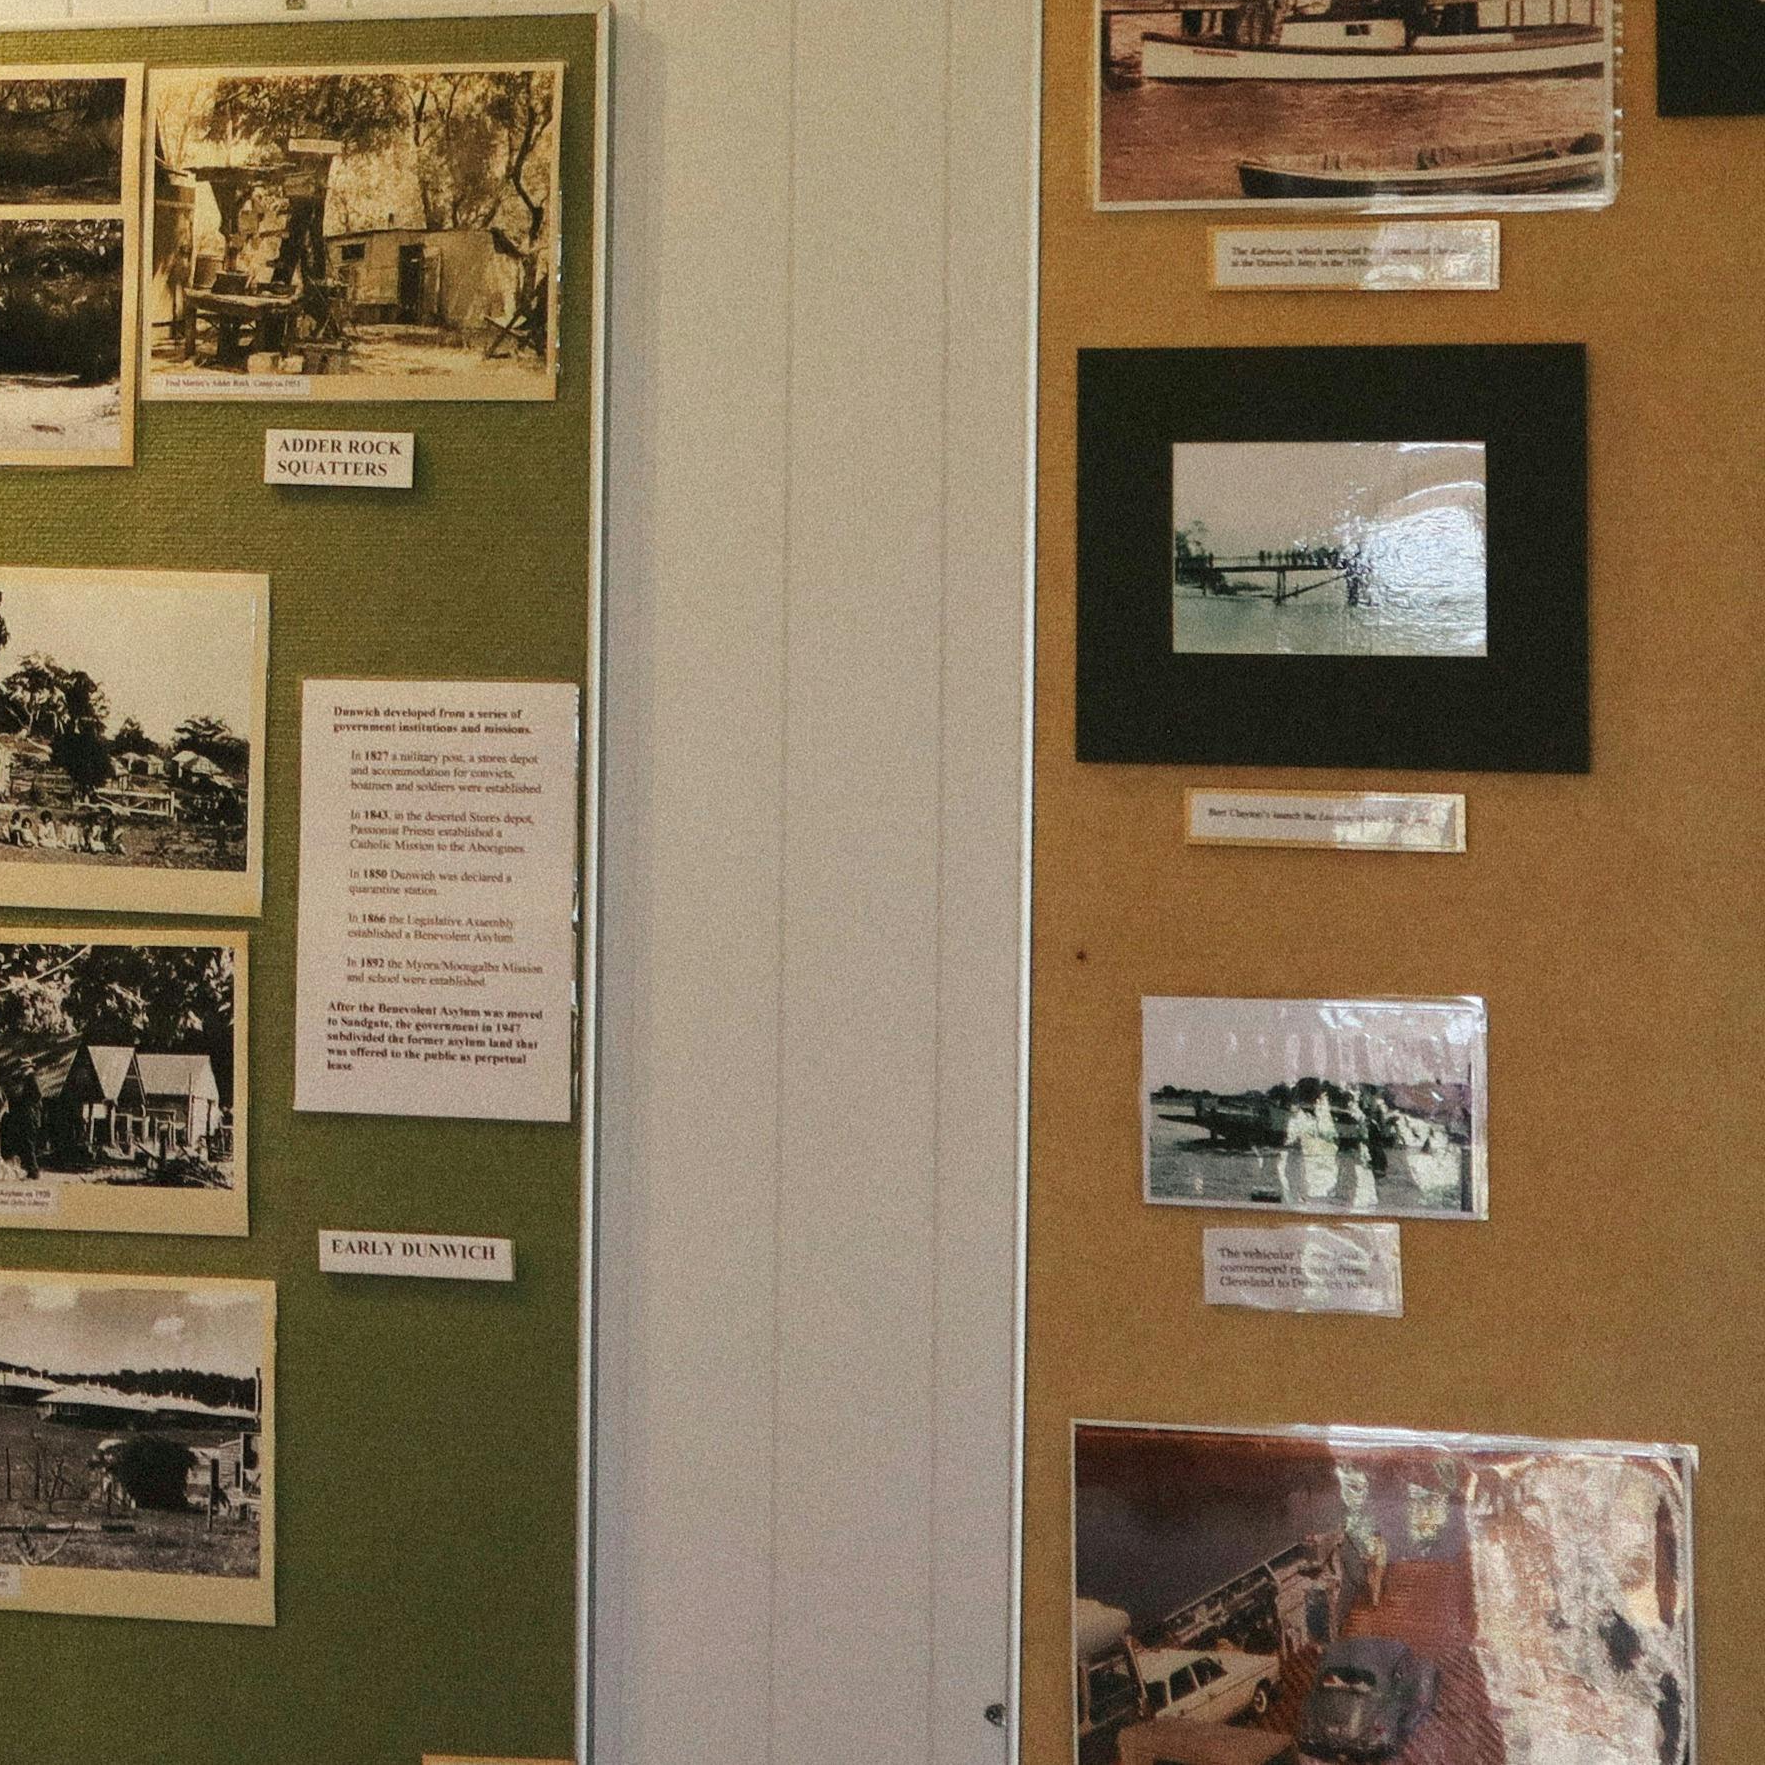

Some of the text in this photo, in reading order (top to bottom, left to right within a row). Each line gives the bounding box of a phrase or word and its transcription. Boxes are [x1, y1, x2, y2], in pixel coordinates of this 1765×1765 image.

[279, 439, 401, 455] ADDER ROCK
[278, 461, 387, 476] SQUATTERS
[334, 707, 381, 717] Dunwich
[383, 708, 437, 719] developed
[438, 708, 466, 718] from
[477, 709, 508, 718] series
[510, 709, 523, 718] of
[333, 722, 396, 734] government
[398, 723, 458, 733] institutions
[460, 724, 481, 733] and
[350, 869, 359, 878] In
[390, 870, 435, 880] Dunwich
[460, 872, 504, 882] declared
[328, 1003, 355, 1013] After
[358, 1004, 375, 1013] the
[378, 1004, 437, 1015] Benevolent
[440, 1006, 481, 1018] Asylum
[506, 1008, 543, 1018] moved
[328, 1017, 338, 1026] to
[395, 1019, 411, 1029] the
[414, 1020, 479, 1033] government
[481, 1022, 493, 1031] in
[495, 1023, 521, 1032] 1947
[328, 1031, 538, 1048] subdivided the former asylum land that
[350, 1048, 388, 1058] offered
[390, 1049, 401, 1058] to
[403, 1050, 420, 1059] the
[423, 1050, 456, 1062] public
[473, 1052, 527, 1065] perpetual
[332, 1239, 497, 1261] EARLY DUNWICH
[1218, 1249, 1294, 1259] The vehicular
[1220, 1265, 1287, 1273] commenced
[1220, 1277, 1289, 1288] Cleveland to
